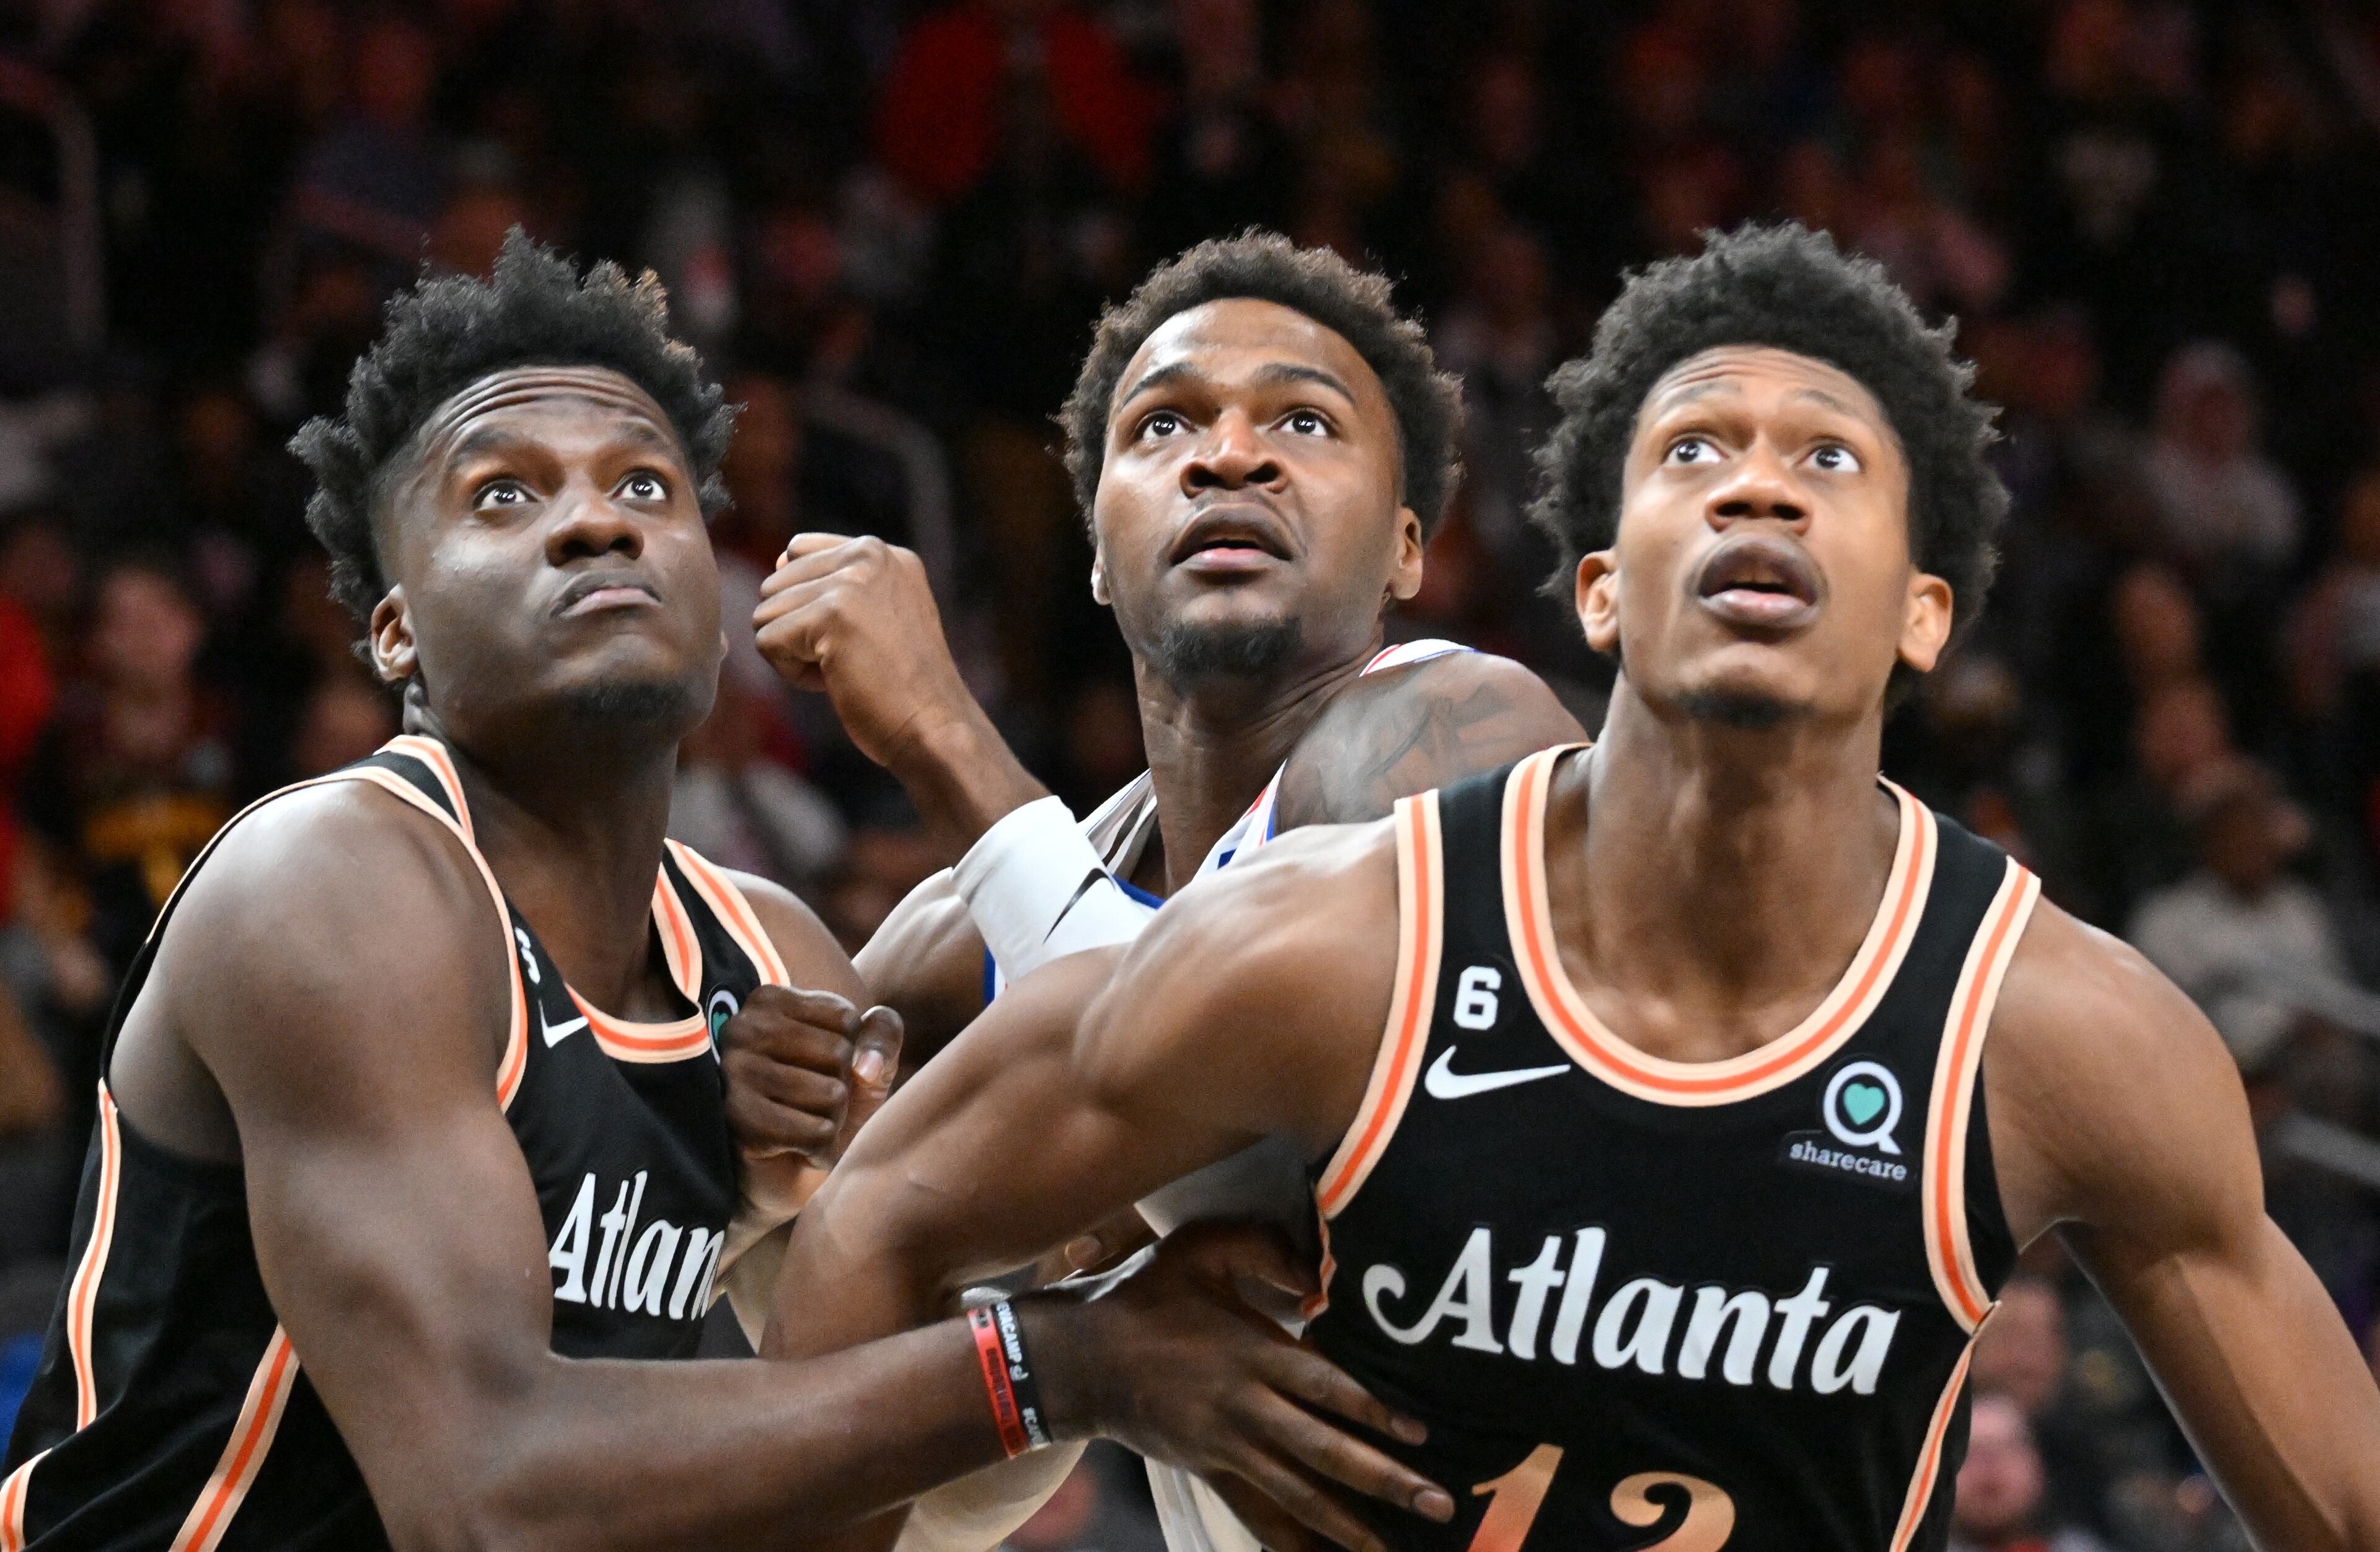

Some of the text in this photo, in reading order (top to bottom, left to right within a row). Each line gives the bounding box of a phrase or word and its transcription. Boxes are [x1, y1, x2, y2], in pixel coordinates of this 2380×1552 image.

[1453, 966, 1501, 1031] 6
[1789, 1140, 1907, 1181] sharecare
[1363, 1227, 1901, 1395] Atlanta
